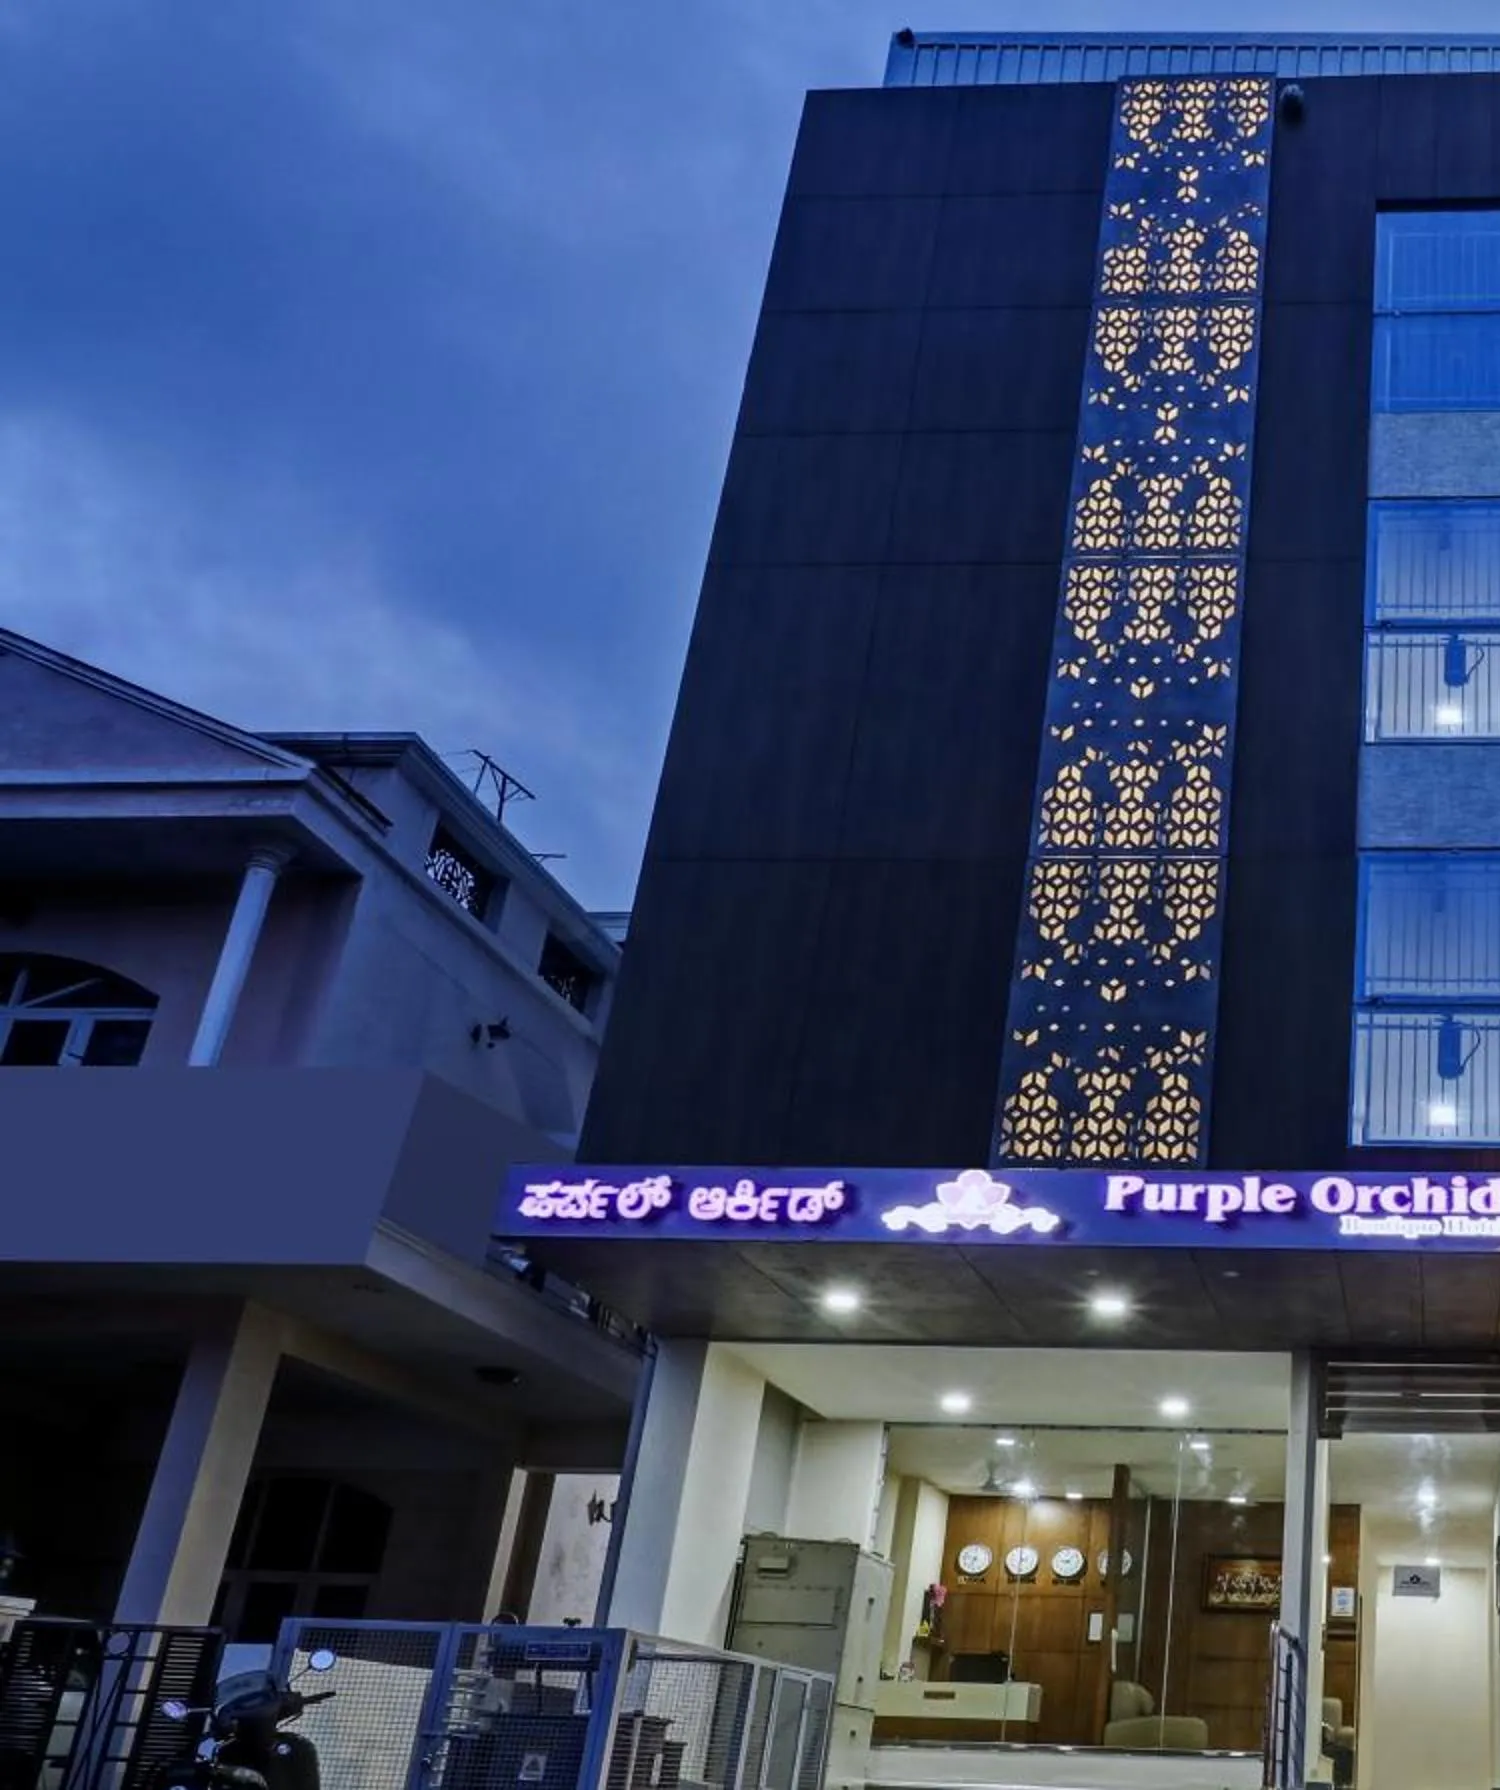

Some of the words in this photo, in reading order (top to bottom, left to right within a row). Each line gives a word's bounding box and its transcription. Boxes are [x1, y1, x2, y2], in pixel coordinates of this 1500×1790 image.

[518, 1174, 673, 1220] ಪರ್ಪಲ್
[687, 1179, 845, 1222] ಆರ್ಕಿಡ್
[1103, 1175, 1298, 1224] Purple
